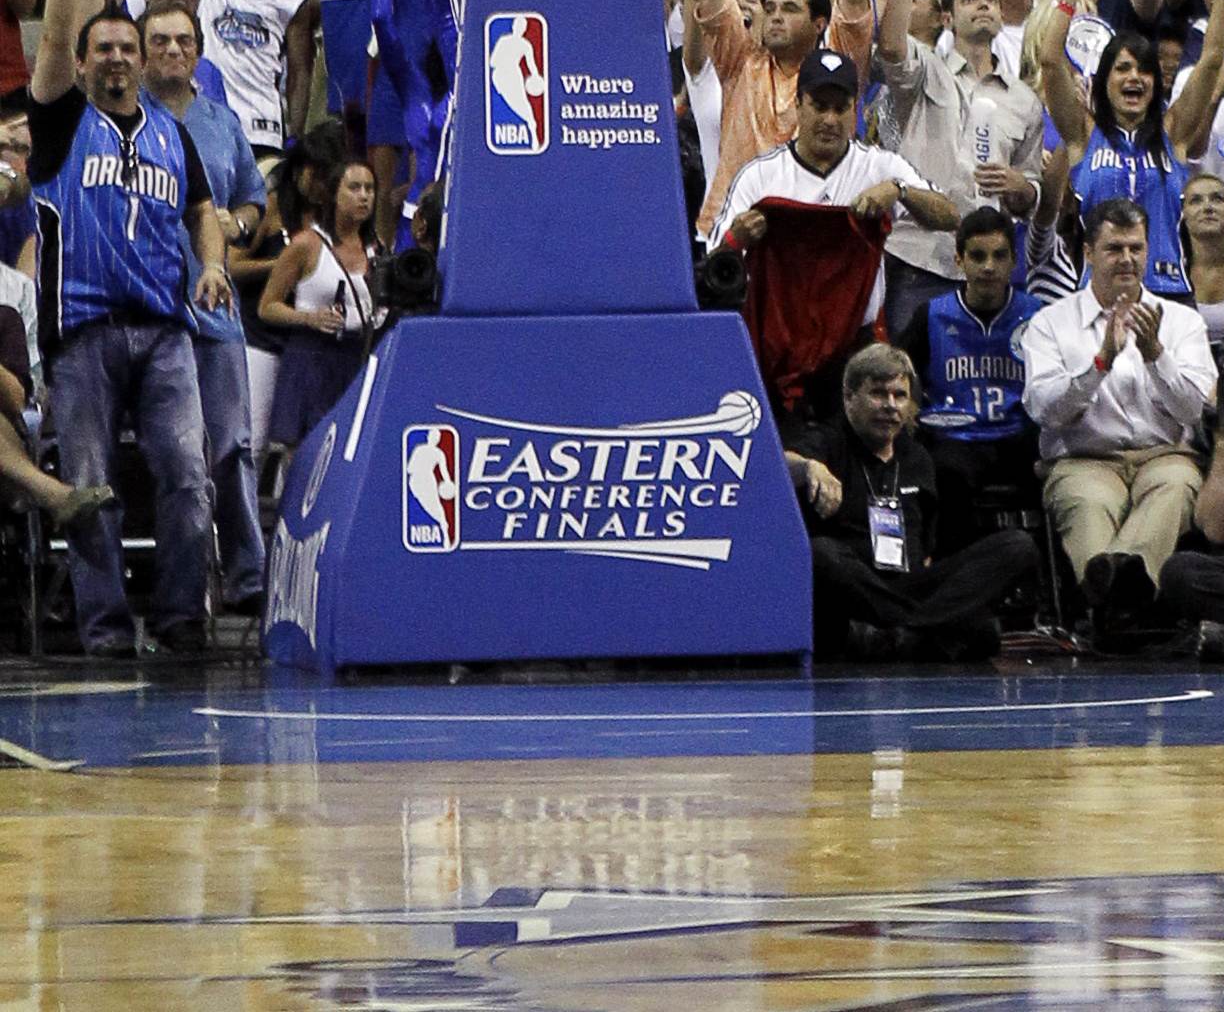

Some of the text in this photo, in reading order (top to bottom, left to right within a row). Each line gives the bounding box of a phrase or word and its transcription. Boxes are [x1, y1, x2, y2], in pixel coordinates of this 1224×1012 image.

[561, 75, 634, 94] Where
[561, 100, 660, 123] amazing
[495, 124, 530, 145] NBA
[562, 125, 662, 149] happens.
[972, 387, 1004, 422] 12
[467, 437, 753, 483] EASTERN
[463, 484, 741, 510] CONFERENCE
[410, 524, 441, 544] NBA
[503, 511, 688, 539] FINALS
